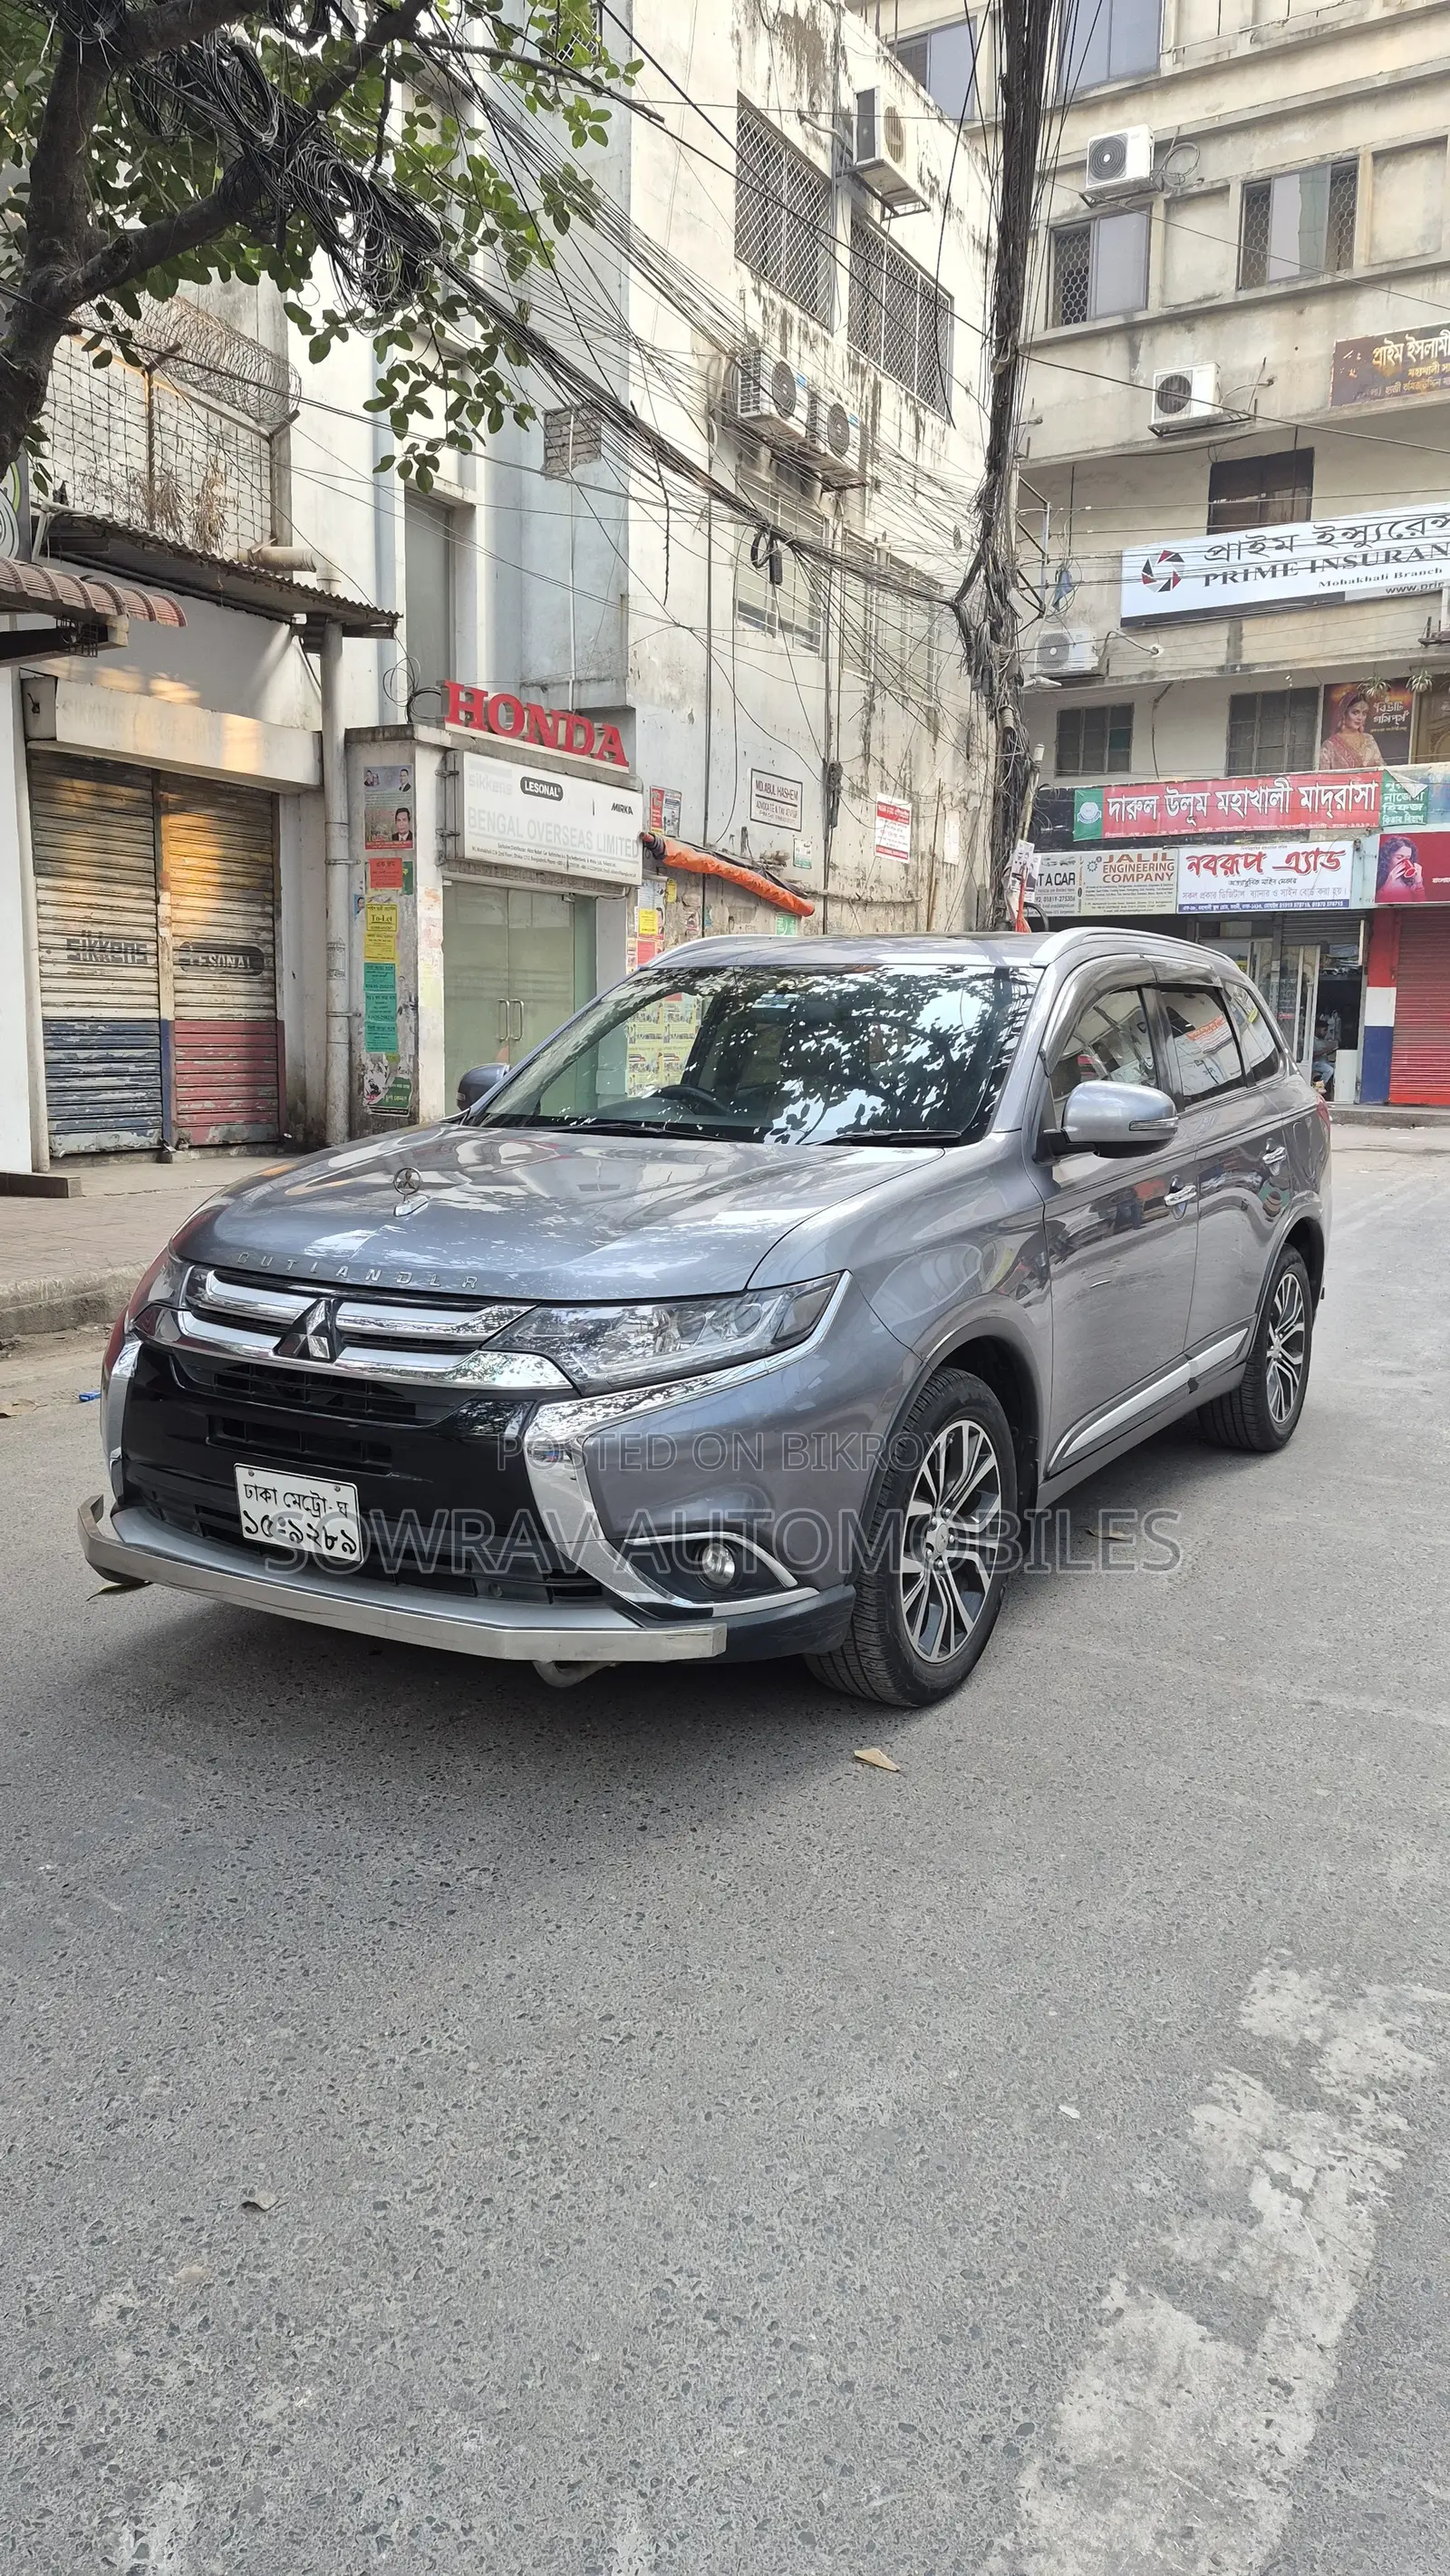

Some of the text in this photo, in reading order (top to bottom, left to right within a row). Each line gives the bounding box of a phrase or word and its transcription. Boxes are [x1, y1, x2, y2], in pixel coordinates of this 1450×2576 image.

[1371, 338, 1405, 367] প্রাইম
[1204, 533, 1300, 564] প্রাইম
[1203, 541, 1450, 588] PRIME INSURAN
[1319, 567, 1443, 589] Mohakhali Branch
[444, 680, 630, 768] HONDA
[611, 802, 634, 816] MIRKA
[1107, 793, 1160, 823] দারুল
[1164, 784, 1211, 827] উলূম
[1214, 776, 1294, 819] মহাখালী
[468, 806, 640, 858] BENGAL OVERSEAS LIMITED
[1103, 852, 1174, 864] JALIL
[1103, 862, 1174, 874] ENGINEERING
[1186, 851, 1267, 878] নবরূপ
[1054, 872, 1076, 886] CAR
[1102, 872, 1174, 884] COMPANY
[243, 1483, 278, 1506] ঢাকা
